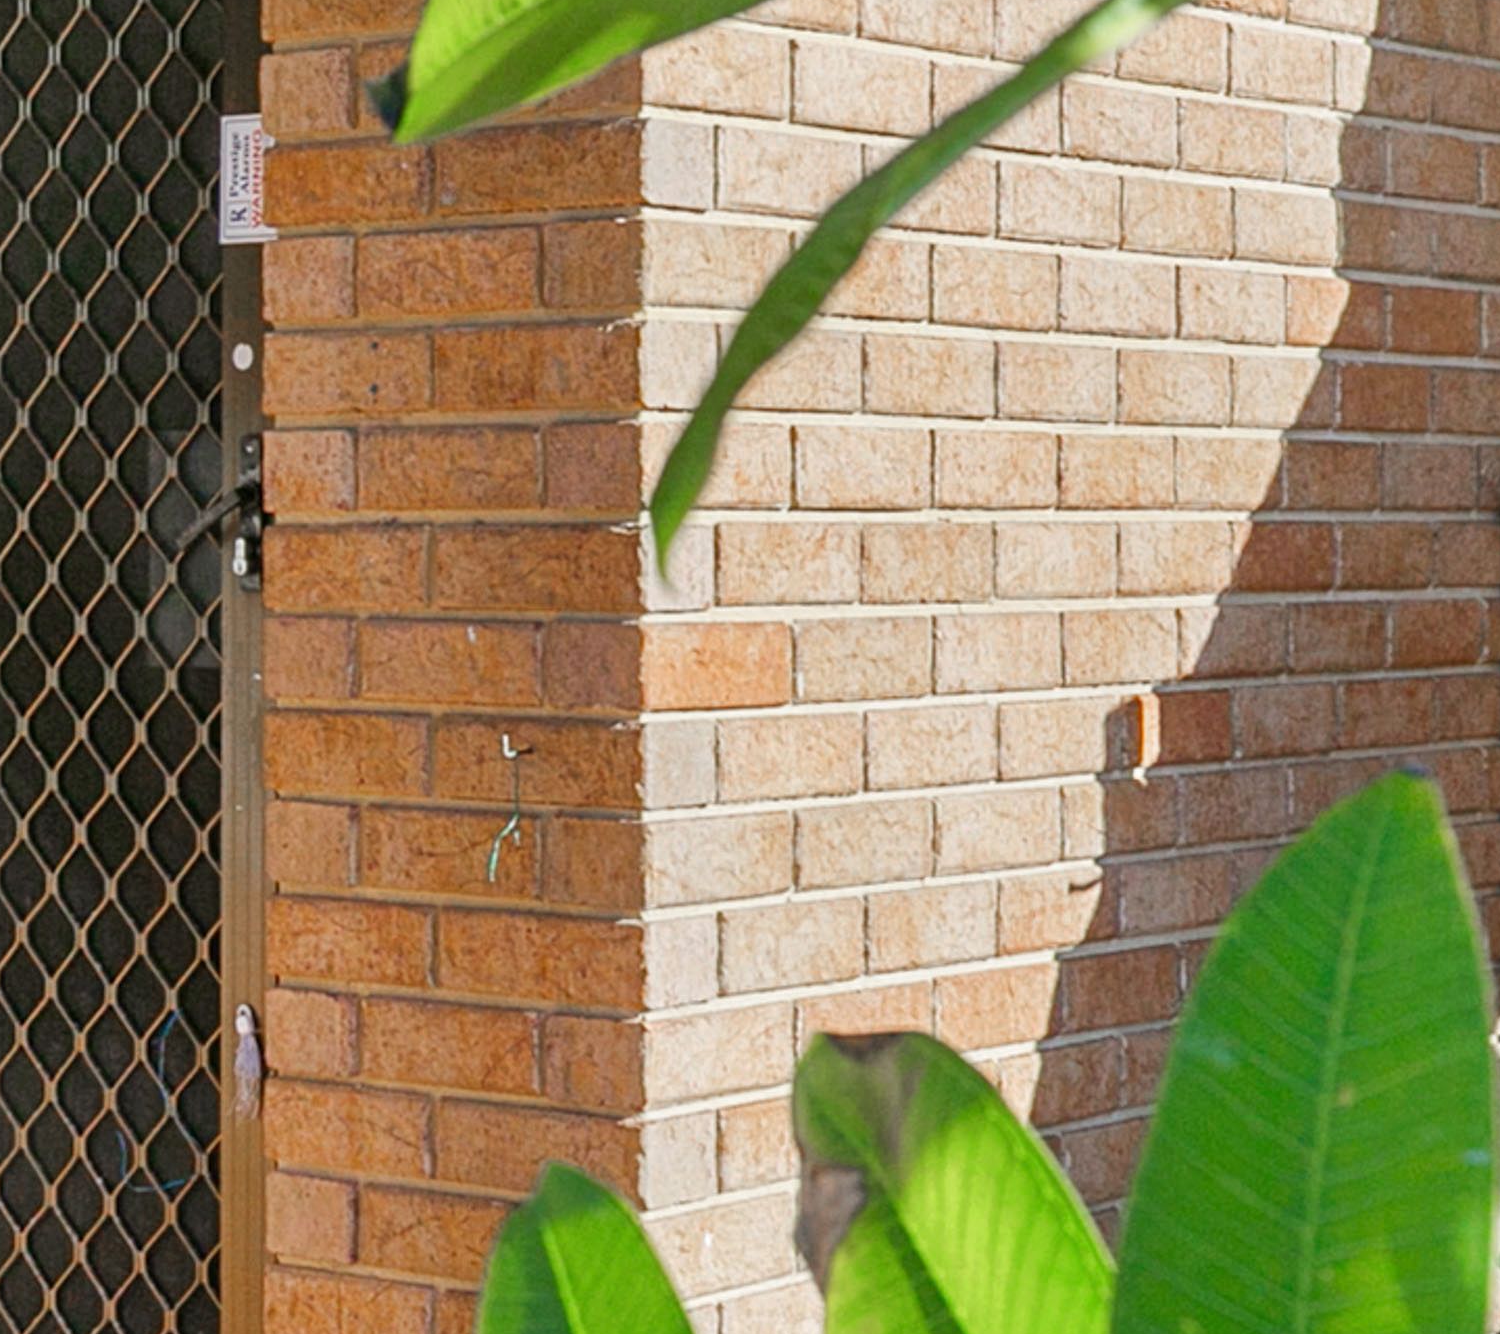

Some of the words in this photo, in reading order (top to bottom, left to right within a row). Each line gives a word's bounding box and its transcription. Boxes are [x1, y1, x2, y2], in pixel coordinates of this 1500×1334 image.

[229, 131, 240, 198] Prestige
[241, 134, 250, 194] Alarms
[252, 129, 263, 228] WARNING
